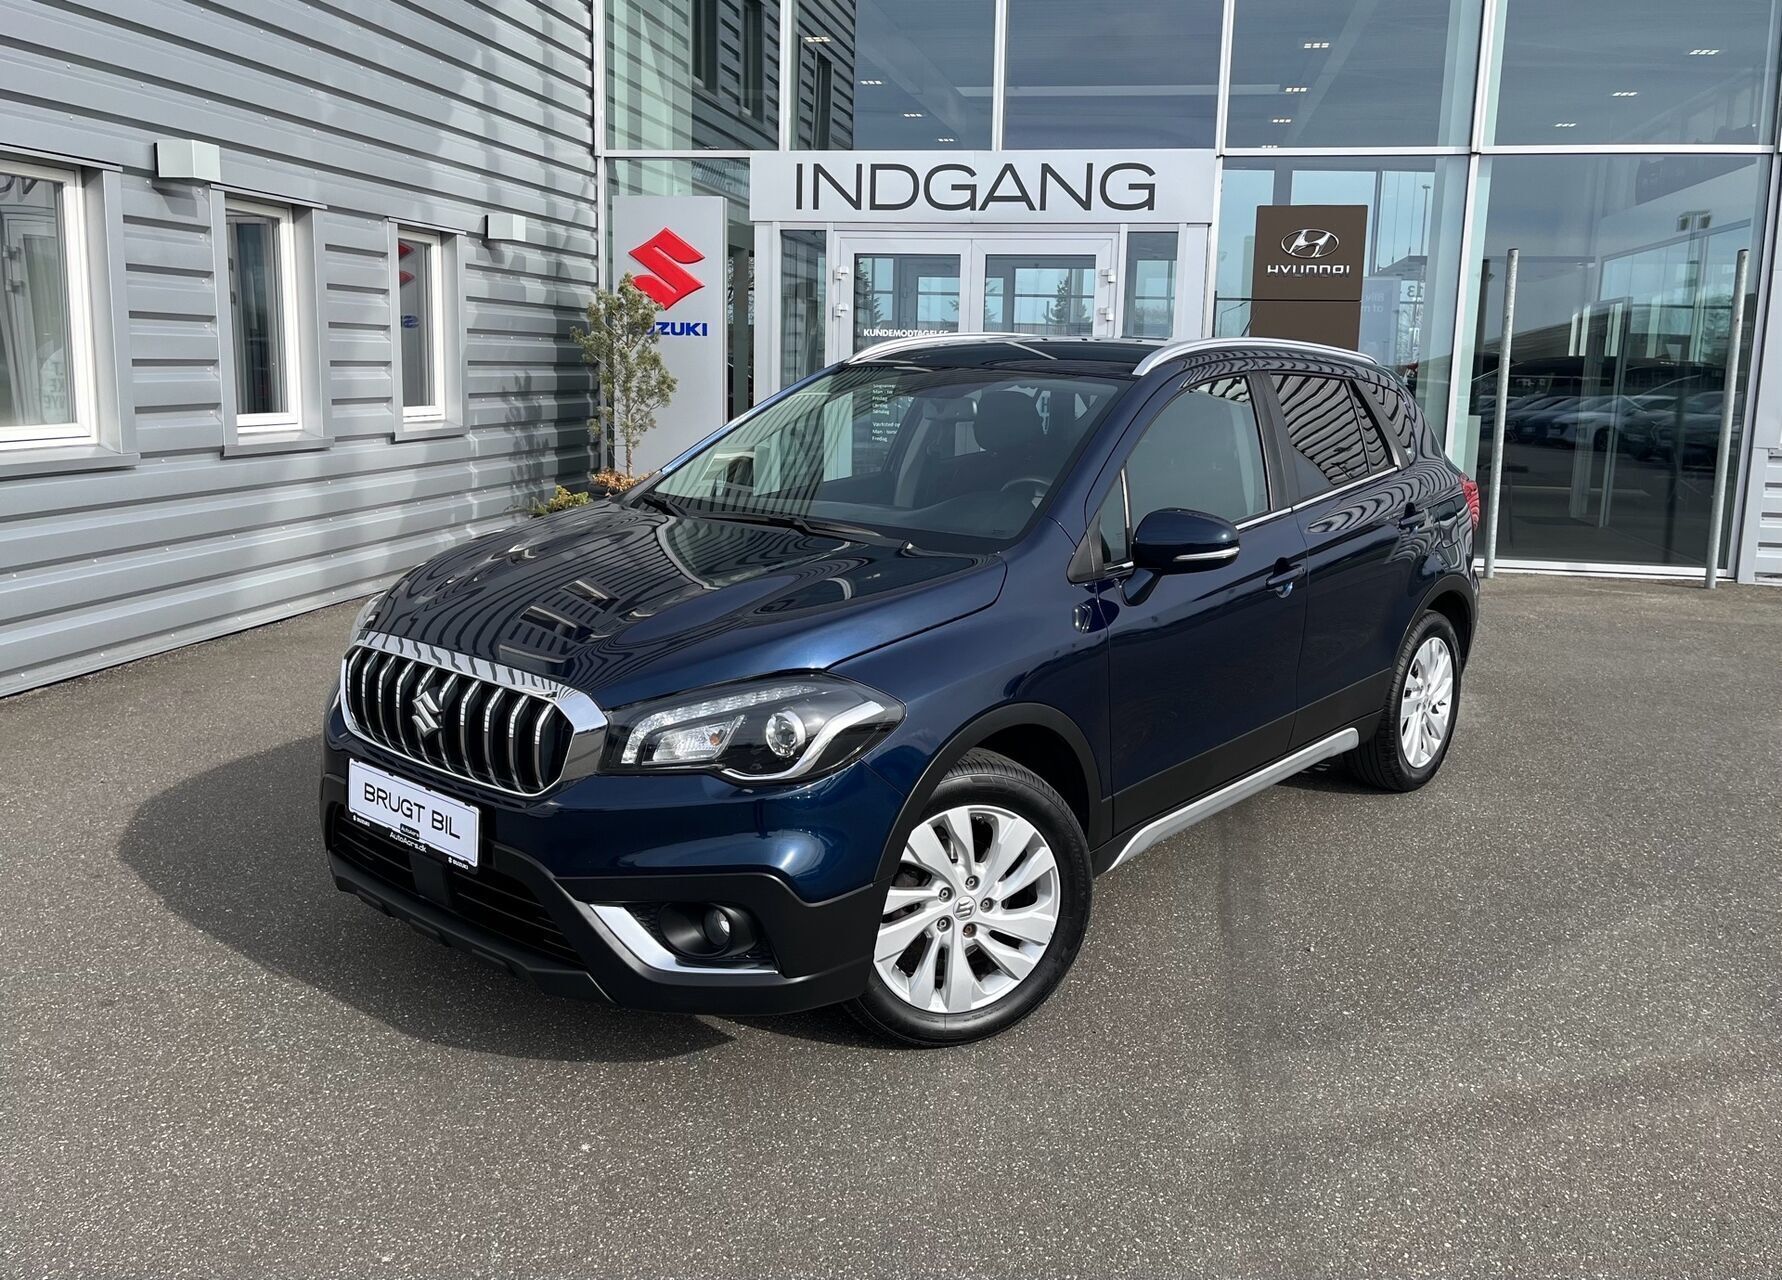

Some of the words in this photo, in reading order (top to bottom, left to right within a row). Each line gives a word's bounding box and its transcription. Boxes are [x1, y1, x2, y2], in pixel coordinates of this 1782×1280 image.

[795, 162, 1156, 211] INDGANG
[1267, 264, 1351, 277] HYUNDAI
[364, 782, 426, 823] BRUGT
[431, 809, 461, 840] BIL
